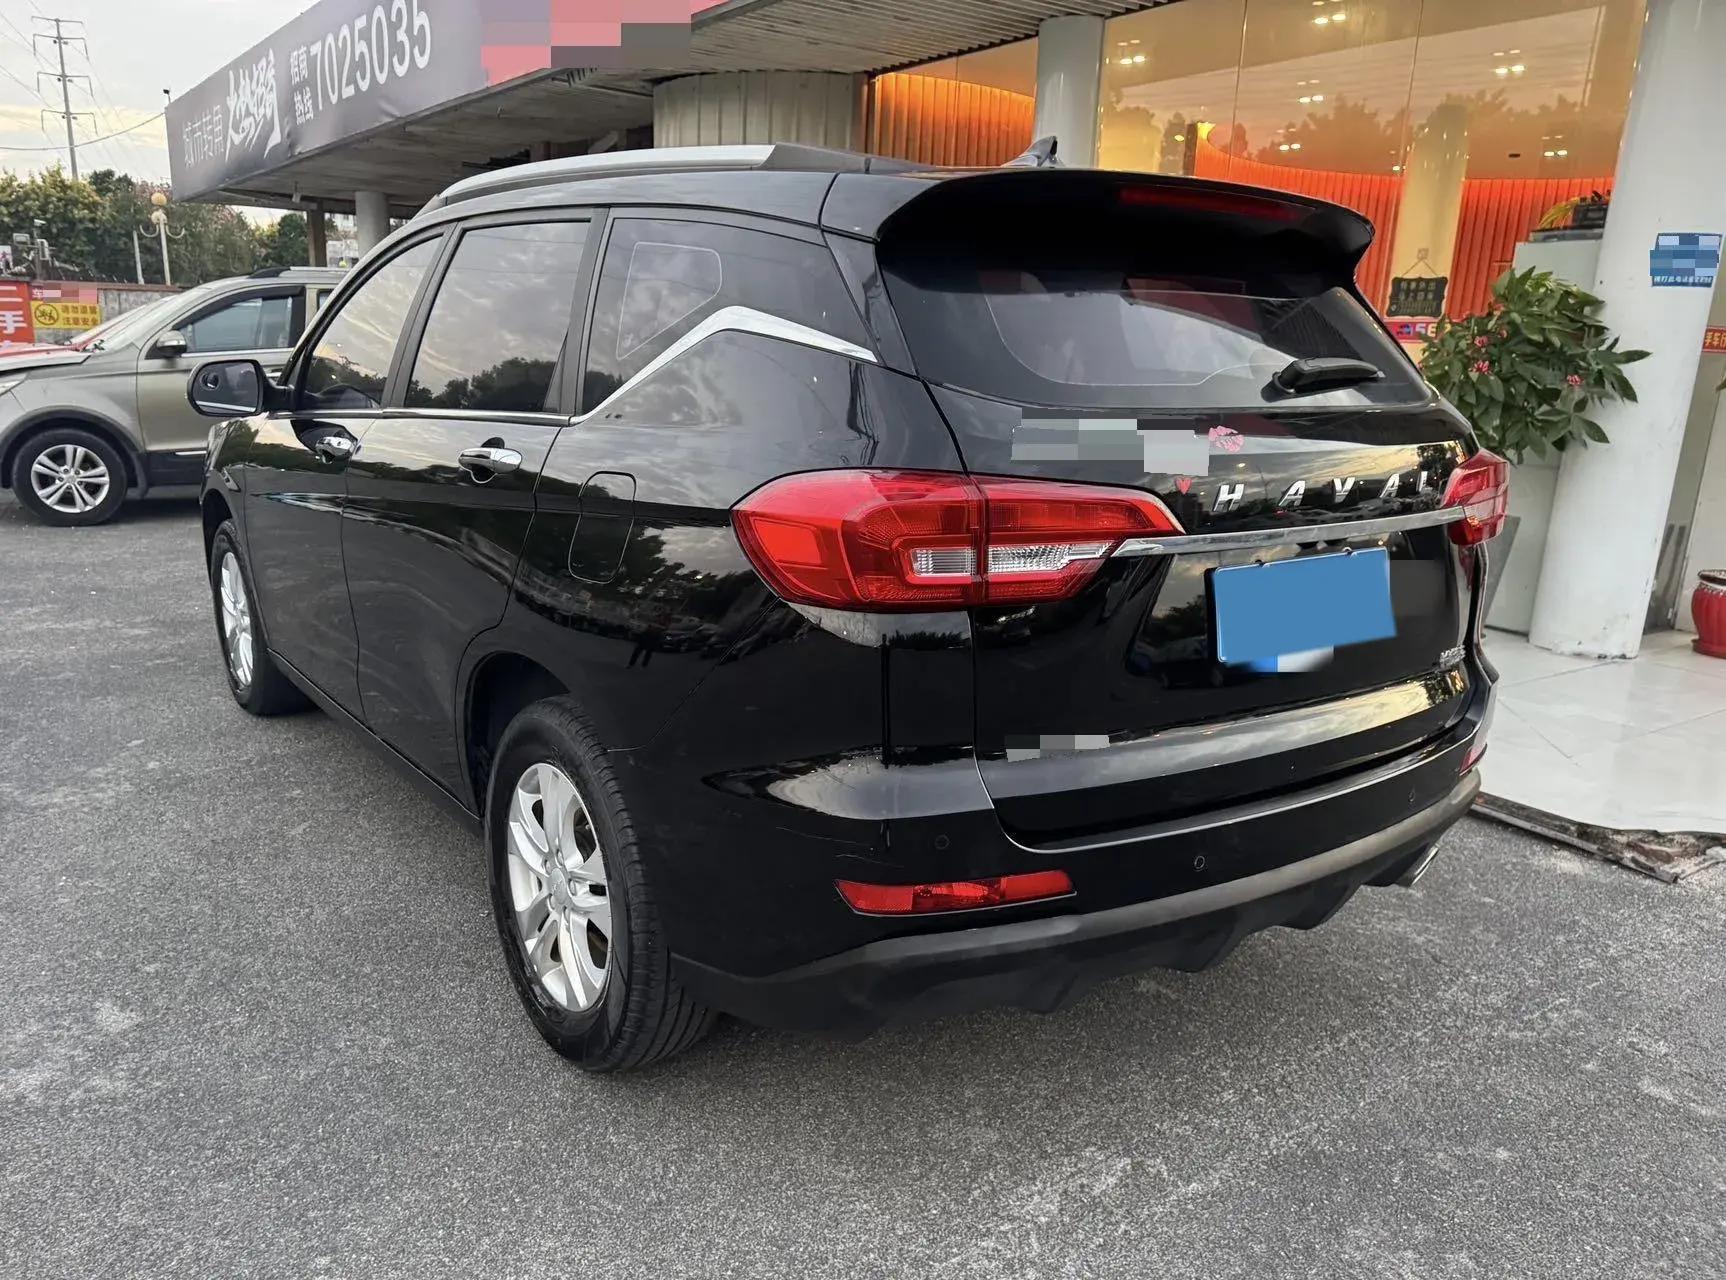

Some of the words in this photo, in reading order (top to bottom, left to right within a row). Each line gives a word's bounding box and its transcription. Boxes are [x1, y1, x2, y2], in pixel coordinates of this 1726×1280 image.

[290, 46, 308, 86] 招商
[310, 0, 431, 111] 7025035
[294, 86, 314, 126] 热线
[1213, 471, 1433, 512] HAVAL
